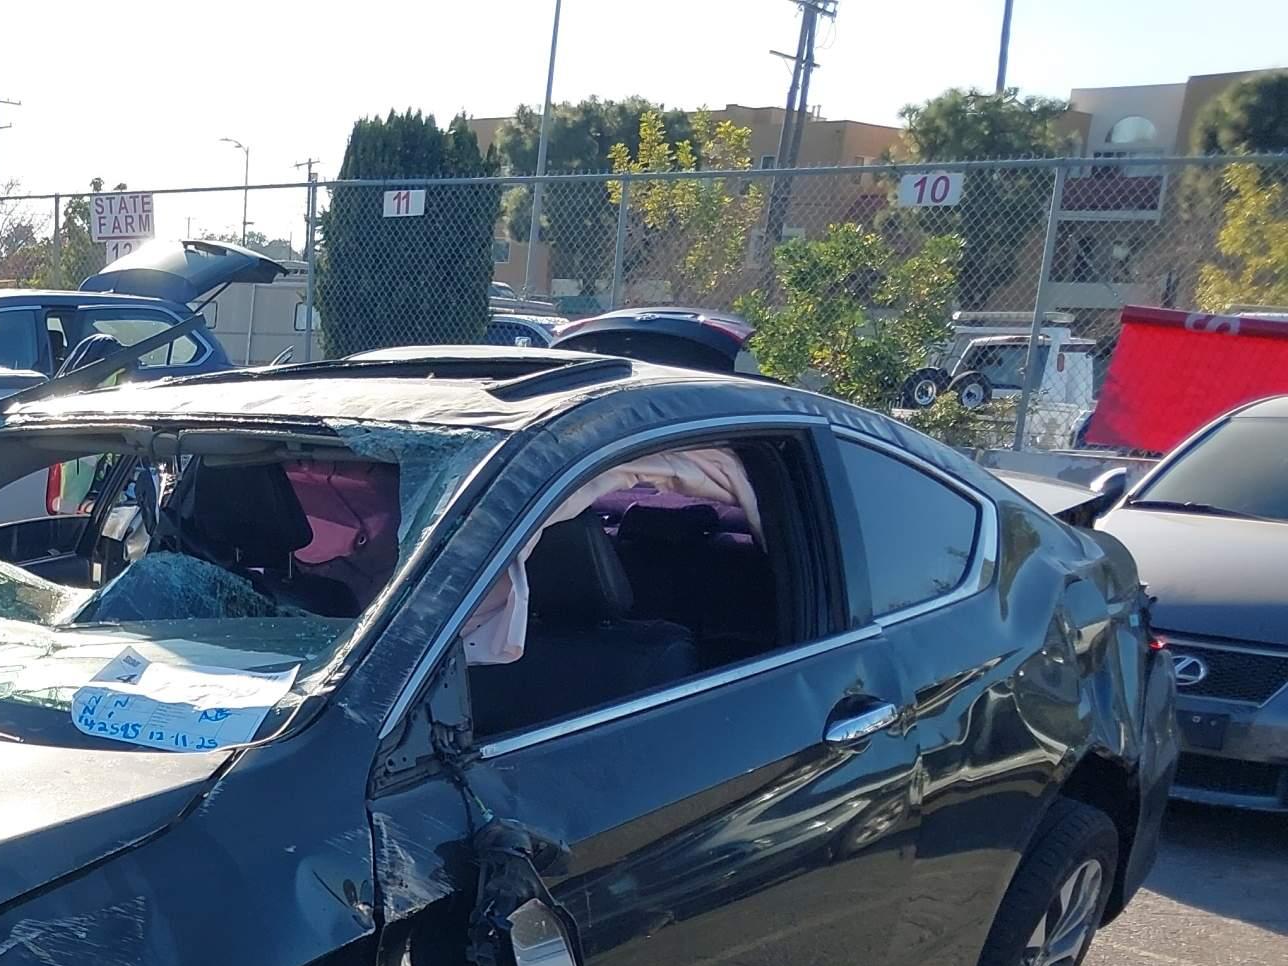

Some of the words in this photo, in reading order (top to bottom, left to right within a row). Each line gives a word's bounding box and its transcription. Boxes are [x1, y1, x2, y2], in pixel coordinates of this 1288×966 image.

[914, 175, 950, 204] 10
[95, 195, 152, 215] STATE
[393, 191, 410, 215] 11
[98, 214, 151, 234] FARM
